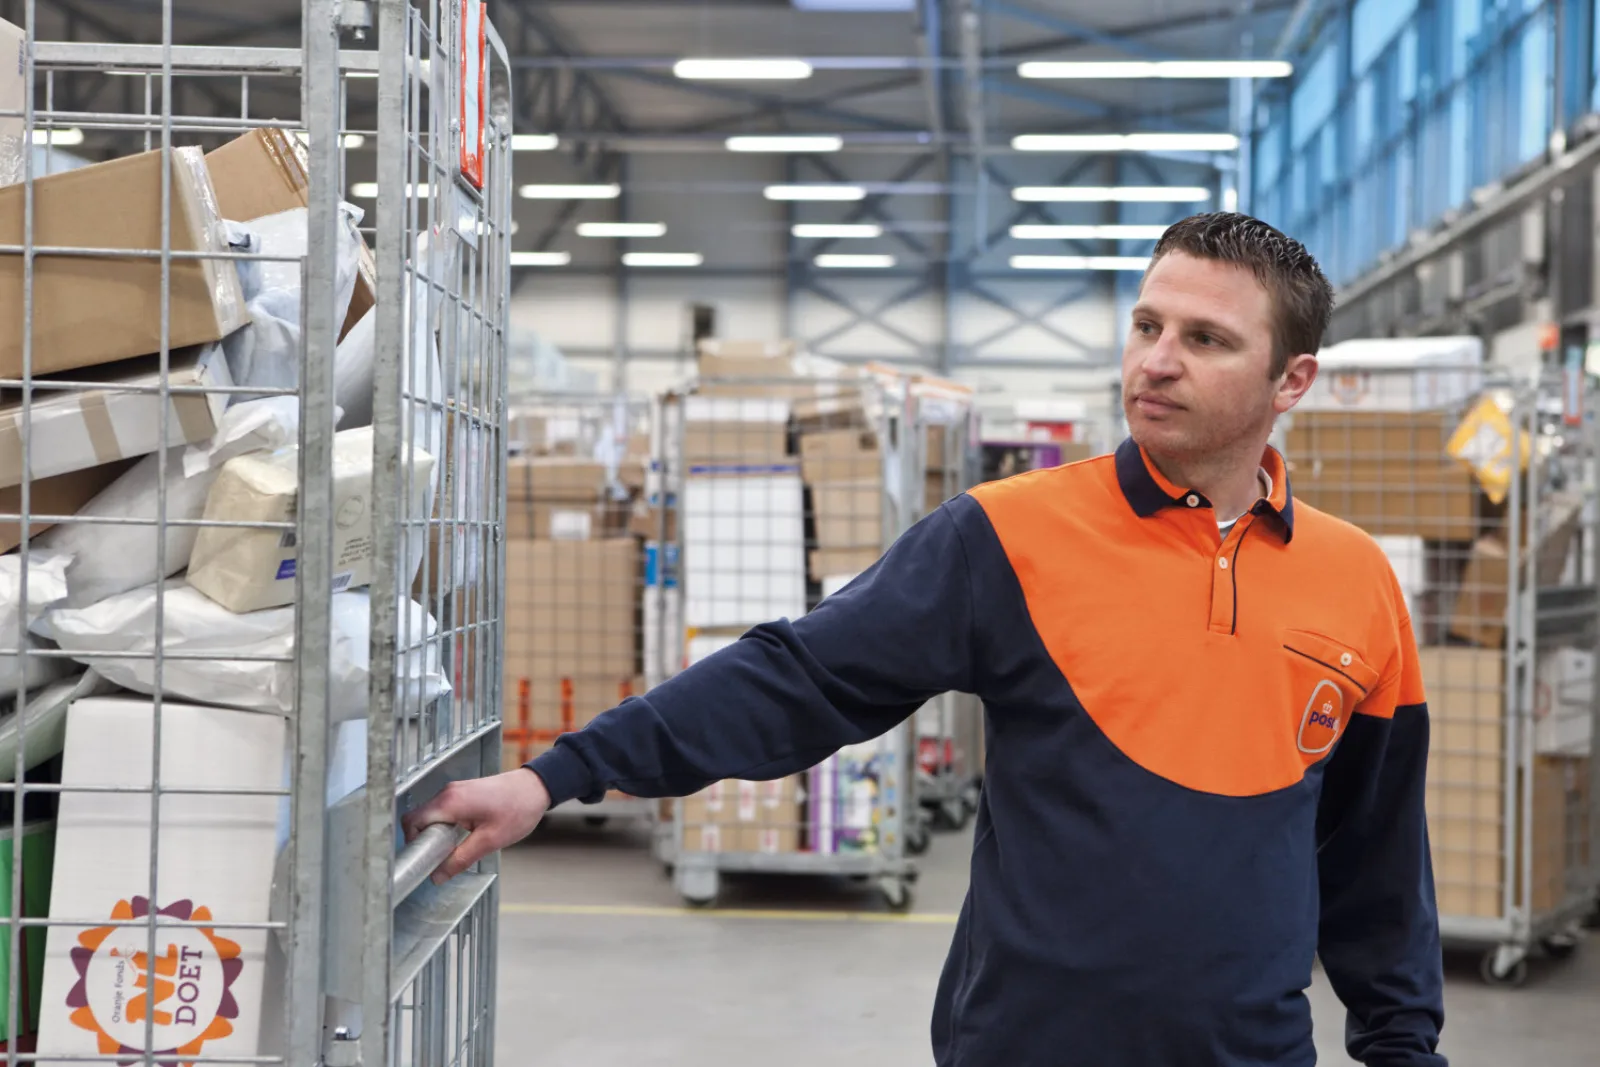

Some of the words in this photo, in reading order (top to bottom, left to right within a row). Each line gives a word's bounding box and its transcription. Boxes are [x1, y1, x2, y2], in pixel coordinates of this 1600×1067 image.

[114, 960, 125, 989] Fonds
[126, 943, 178, 1026] NL
[174, 946, 203, 1026] DOET
[111, 990, 124, 1024] Oranje
